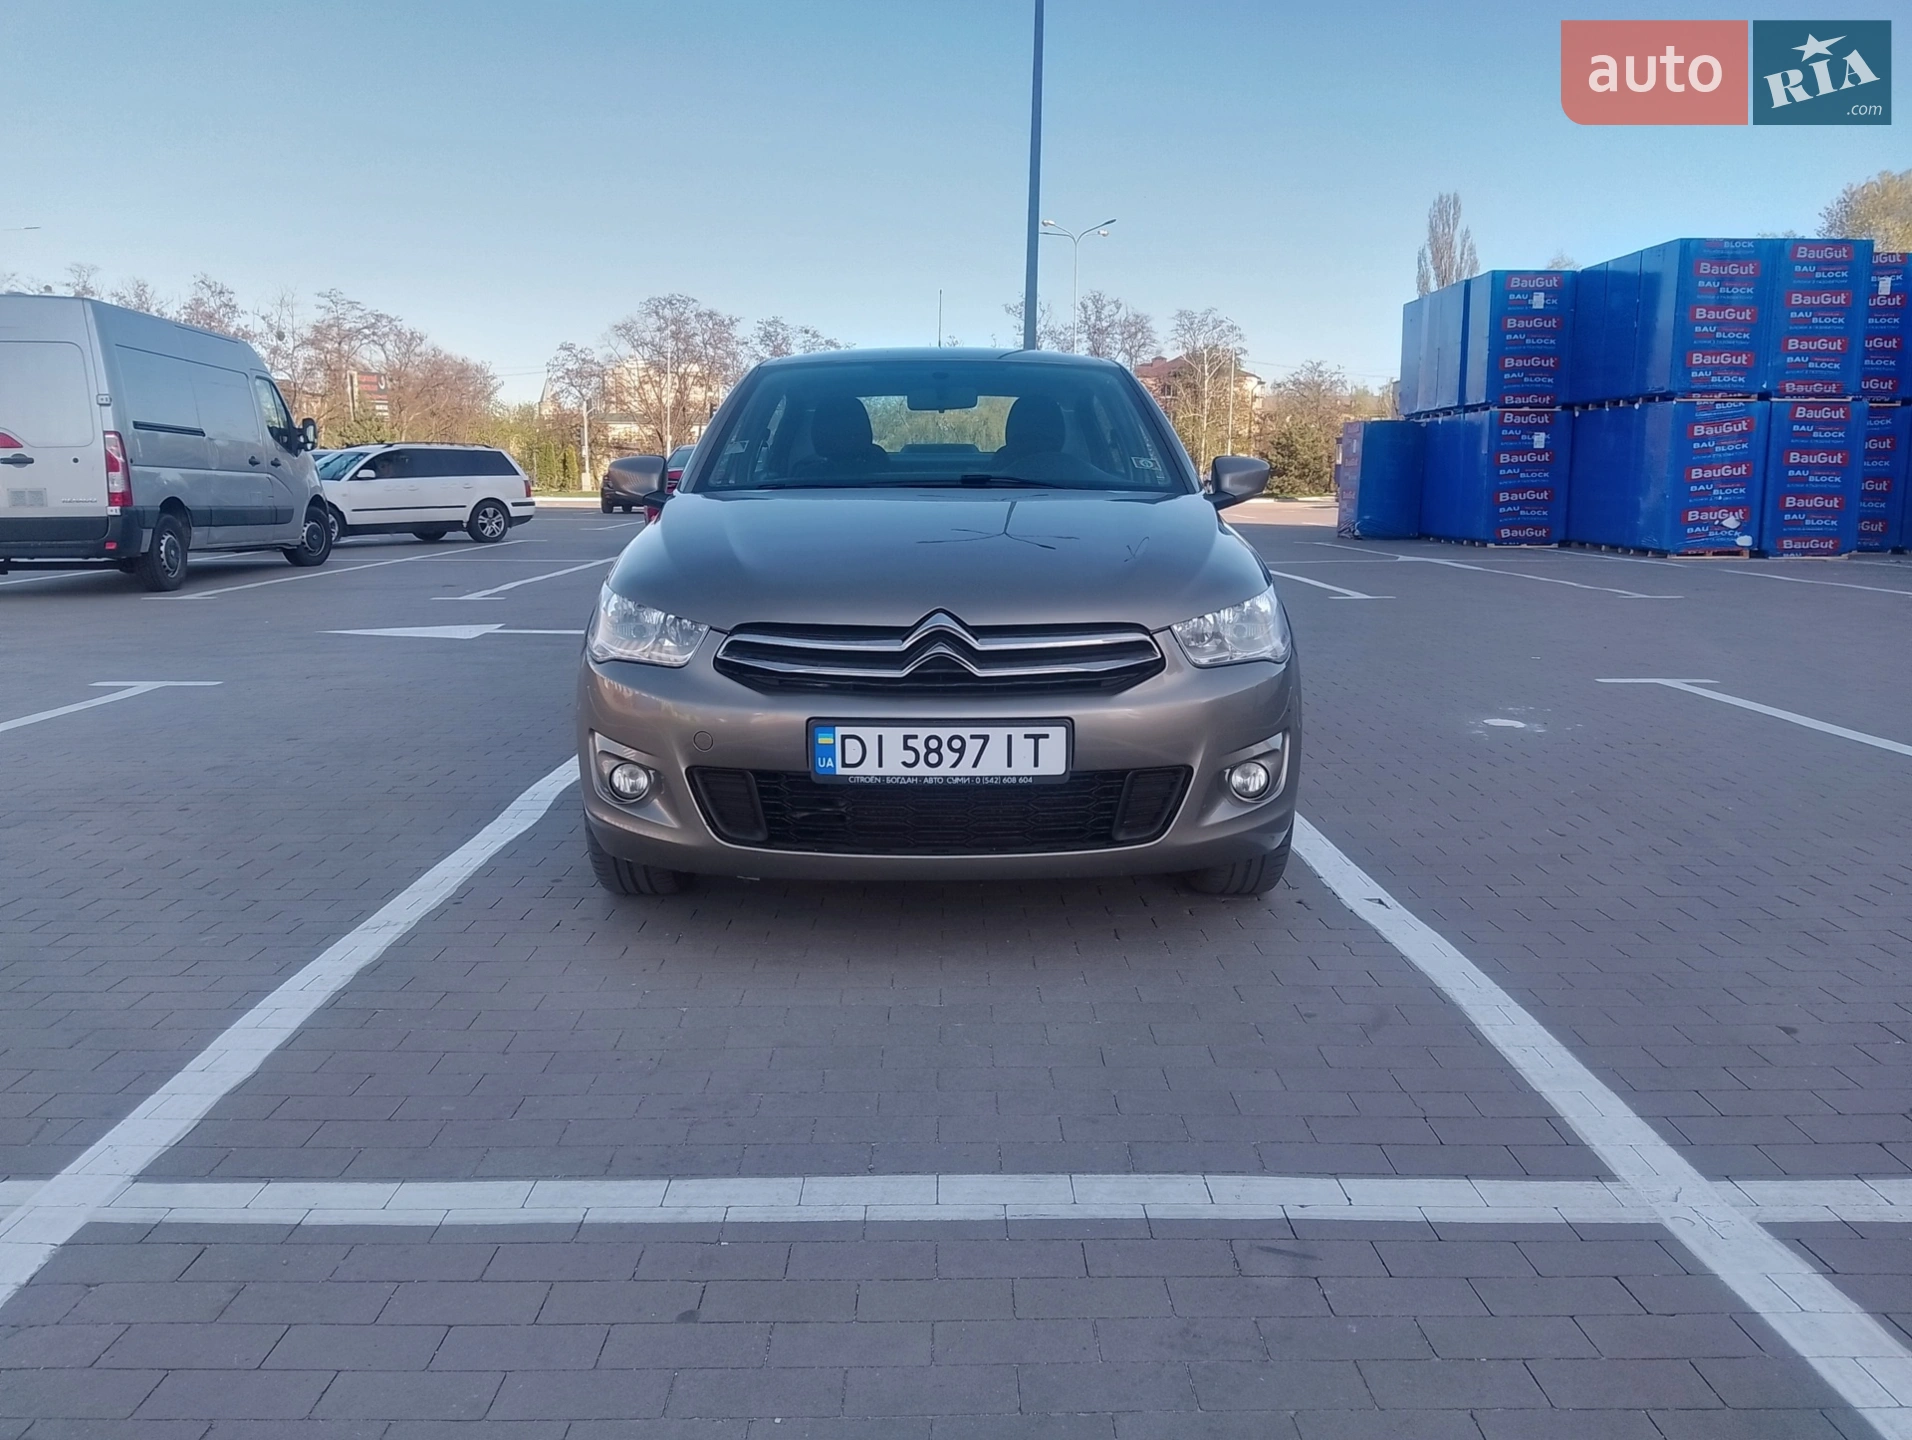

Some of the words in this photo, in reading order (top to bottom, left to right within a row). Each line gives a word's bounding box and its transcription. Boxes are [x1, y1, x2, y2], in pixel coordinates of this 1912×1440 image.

[1796, 246, 1848, 259] BauGut
[1700, 262, 1755, 274] BauGut
[1510, 277, 1559, 288] BauGut
[1791, 293, 1846, 305] BauGut
[1868, 295, 1902, 306] uGut
[1695, 308, 1752, 320] BauGut
[1506, 318, 1557, 329] BauGut
[1788, 339, 1842, 350] BauGut
[1864, 338, 1898, 348] uGut
[1504, 357, 1556, 368] BauGut
[1692, 353, 1748, 365] BauGut
[1785, 382, 1837, 393] BauGut
[1861, 379, 1894, 390] uGut
[1505, 394, 1551, 405] BauGut
[1504, 412, 1550, 424] BauGut
[1795, 407, 1846, 419] BauGut
[1693, 420, 1748, 436] BauGut
[1693, 441, 1715, 449] BAU
[1715, 443, 1749, 452] BLOCK
[1500, 452, 1550, 464] BauGut
[1789, 452, 1842, 464] BauGut
[1691, 464, 1747, 480] BauGut
[1690, 484, 1714, 492] BAU
[1499, 490, 1549, 502] BauGut
[1785, 496, 1840, 508] BauGut
[1688, 508, 1744, 521] BauGut
[1500, 528, 1547, 538] BauGut
[1687, 526, 1709, 534] BAU
[1783, 540, 1834, 549] BauGut
[818, 757, 834, 768] UA
[841, 734, 884, 769] DI
[901, 734, 990, 768] 5897
[1007, 733, 1050, 768] IT
[848, 776, 881, 784] CITROËN
[886, 776, 918, 785] БОГДАН
[923, 776, 944, 784] АВТО
[946, 776, 970, 785] СУМИ
[982, 776, 1000, 785] (542)
[1002, 776, 1017, 784] 608
[1018, 776, 1033, 784] 604
